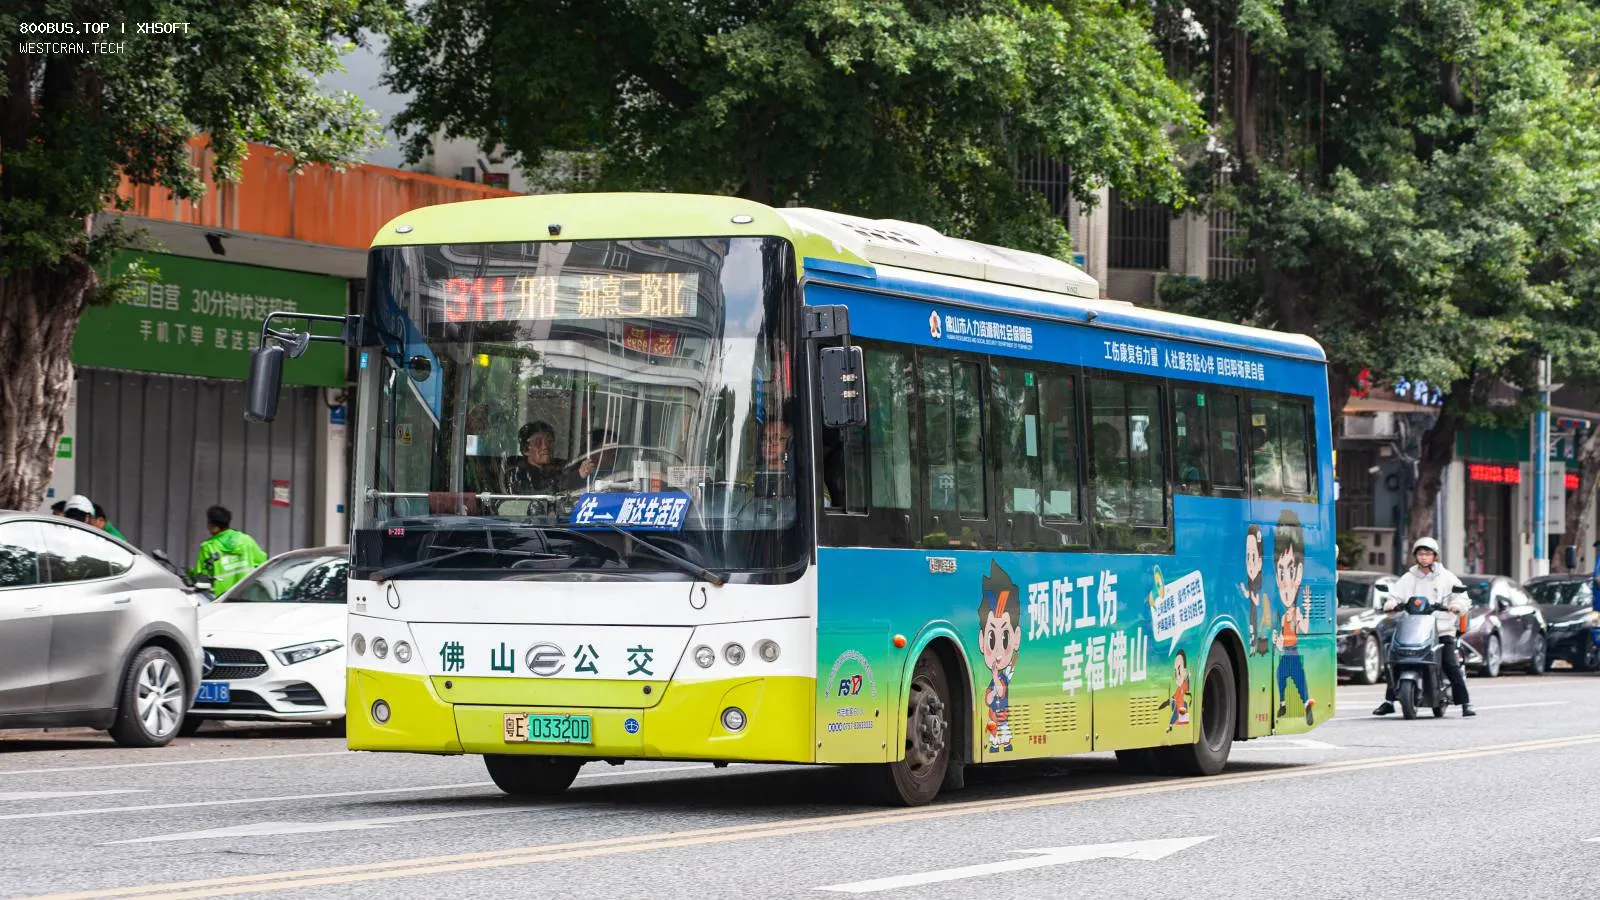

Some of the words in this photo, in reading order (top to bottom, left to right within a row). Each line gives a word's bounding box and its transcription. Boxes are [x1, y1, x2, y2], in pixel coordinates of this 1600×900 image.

[446, 275, 505, 322] 311
[140, 319, 204, 346] 手机下单
[945, 315, 1033, 344] 佛山市人力资源和社会保障局
[1103, 340, 1159, 367] 工伤康复有力量
[1164, 348, 1215, 375] 人社服务贴心伴
[1216, 356, 1265, 382] 回归职场更自信
[575, 496, 599, 524] 往
[616, 497, 687, 528] 顺达生活区
[1027, 569, 1118, 641] 预防工伤
[439, 641, 515, 673] 佛山
[572, 644, 654, 676] 公交
[1062, 626, 1148, 697] 幸福佛山
[532, 718, 589, 739] 03320D
